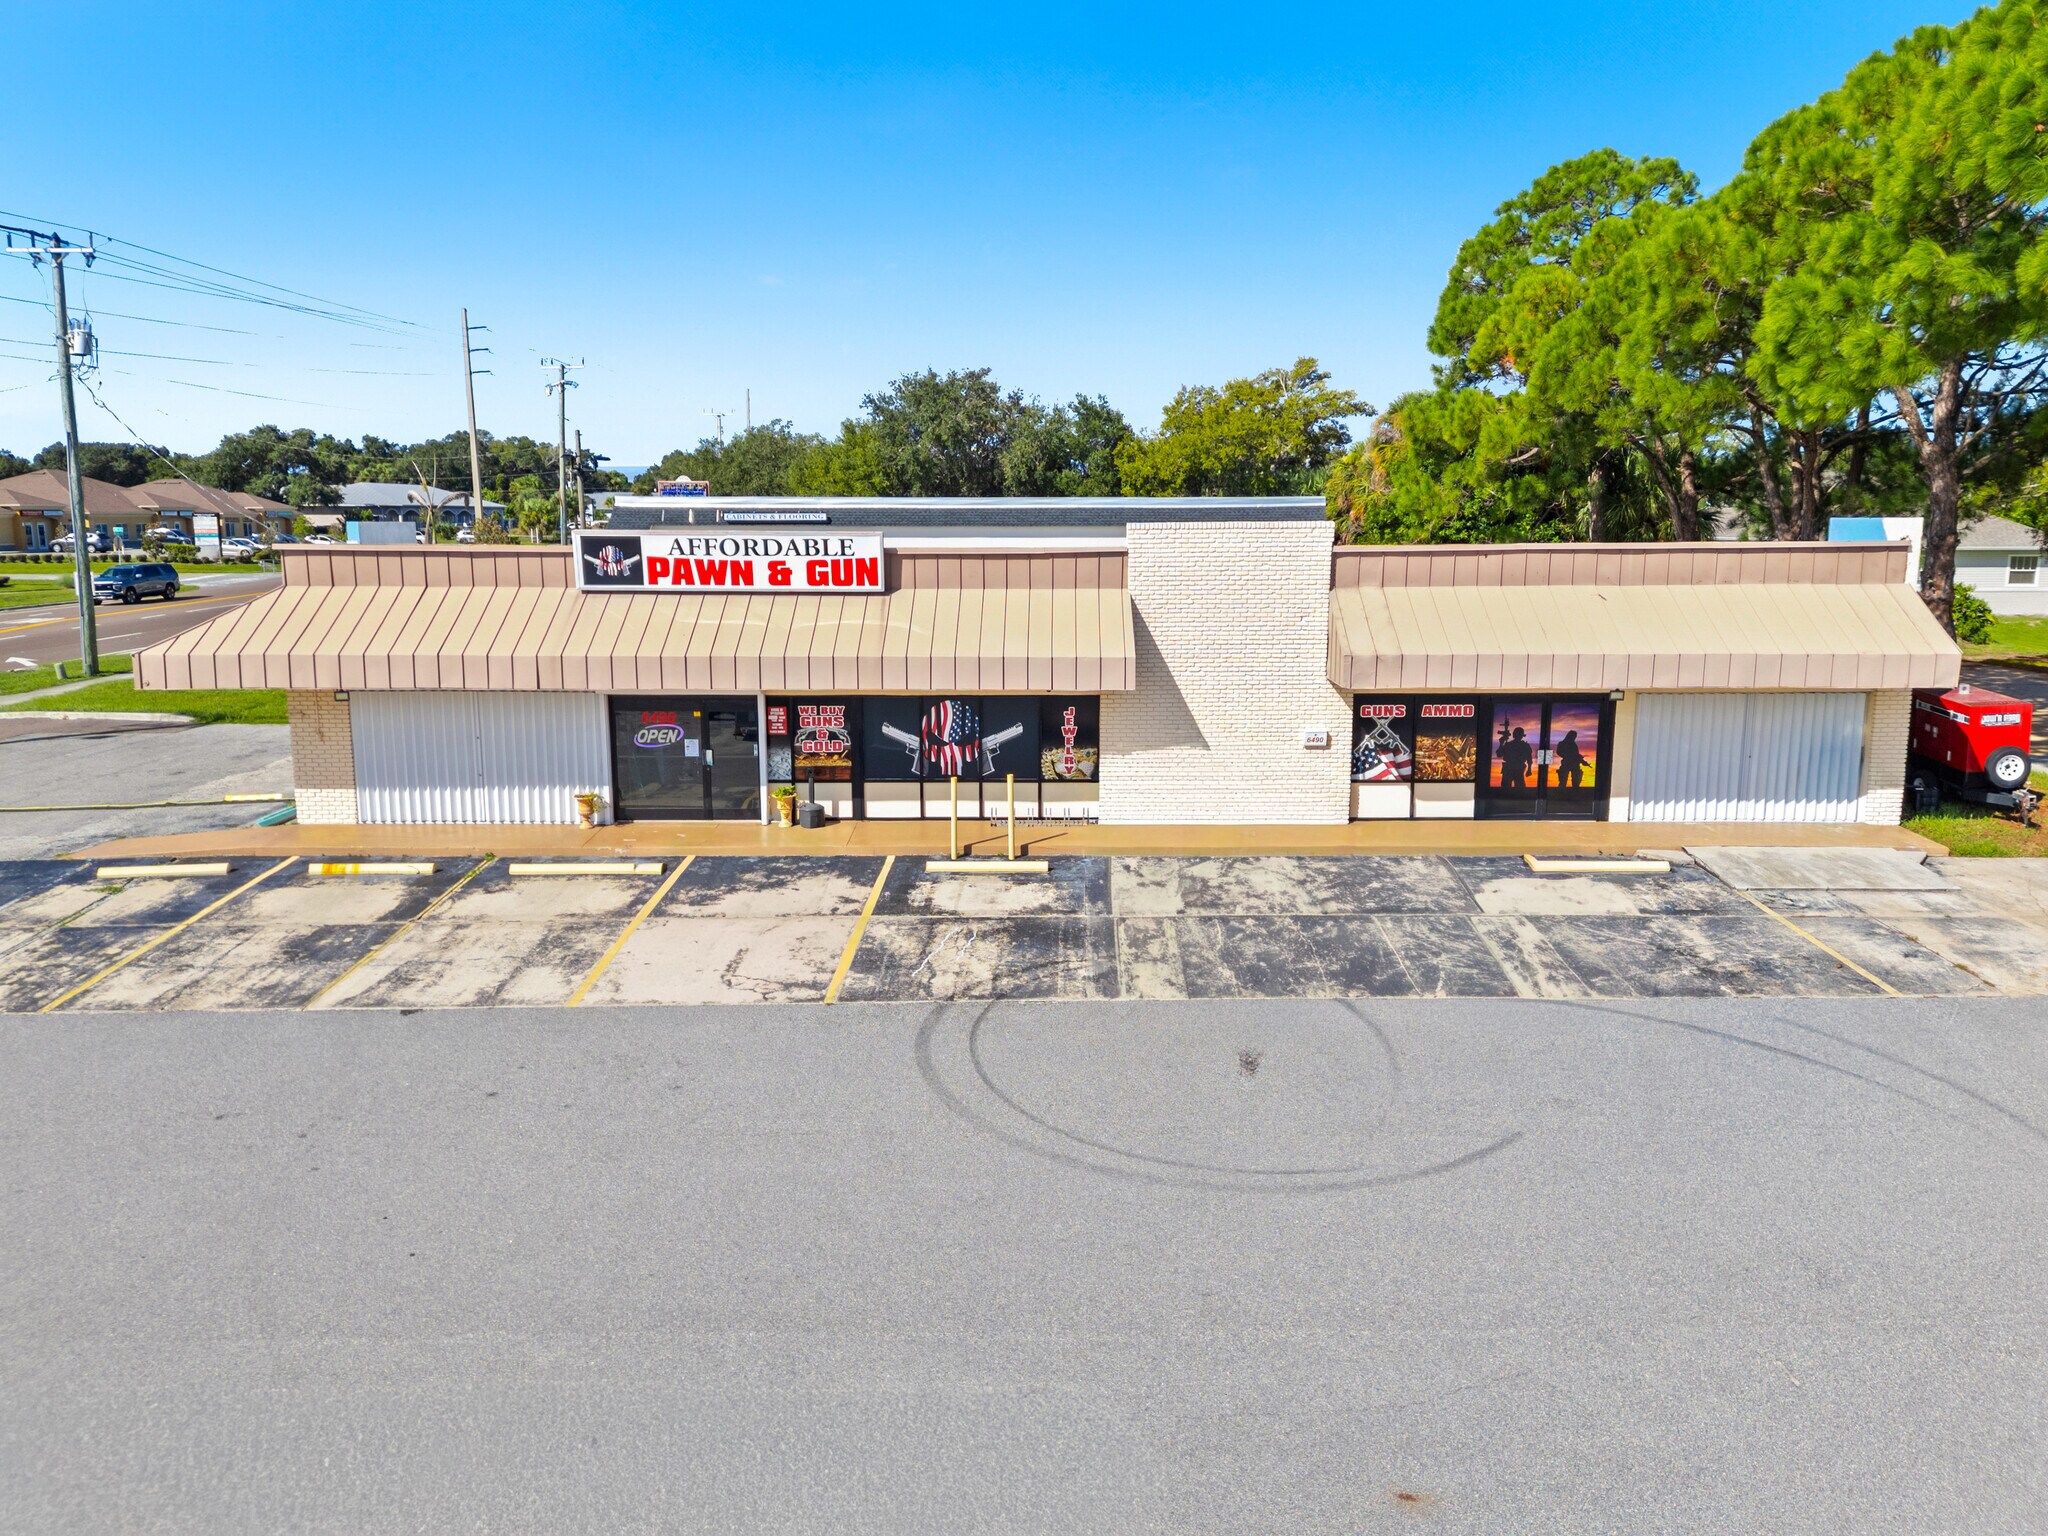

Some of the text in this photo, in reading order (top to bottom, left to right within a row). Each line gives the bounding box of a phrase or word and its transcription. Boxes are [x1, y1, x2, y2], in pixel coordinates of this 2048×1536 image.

[668, 537, 856, 557] AFFORDABLE
[646, 555, 879, 587] PAWN & GUN
[798, 705, 846, 716] WE BUY
[1360, 704, 1407, 718] GUNS
[1421, 704, 1475, 718] AMMO
[641, 711, 677, 725] 6490
[800, 715, 845, 728] GUNS
[637, 729, 679, 743] OPEN
[816, 727, 829, 741] &
[1061, 707, 1078, 775] JEWELRY
[802, 740, 844, 753] GOLD
